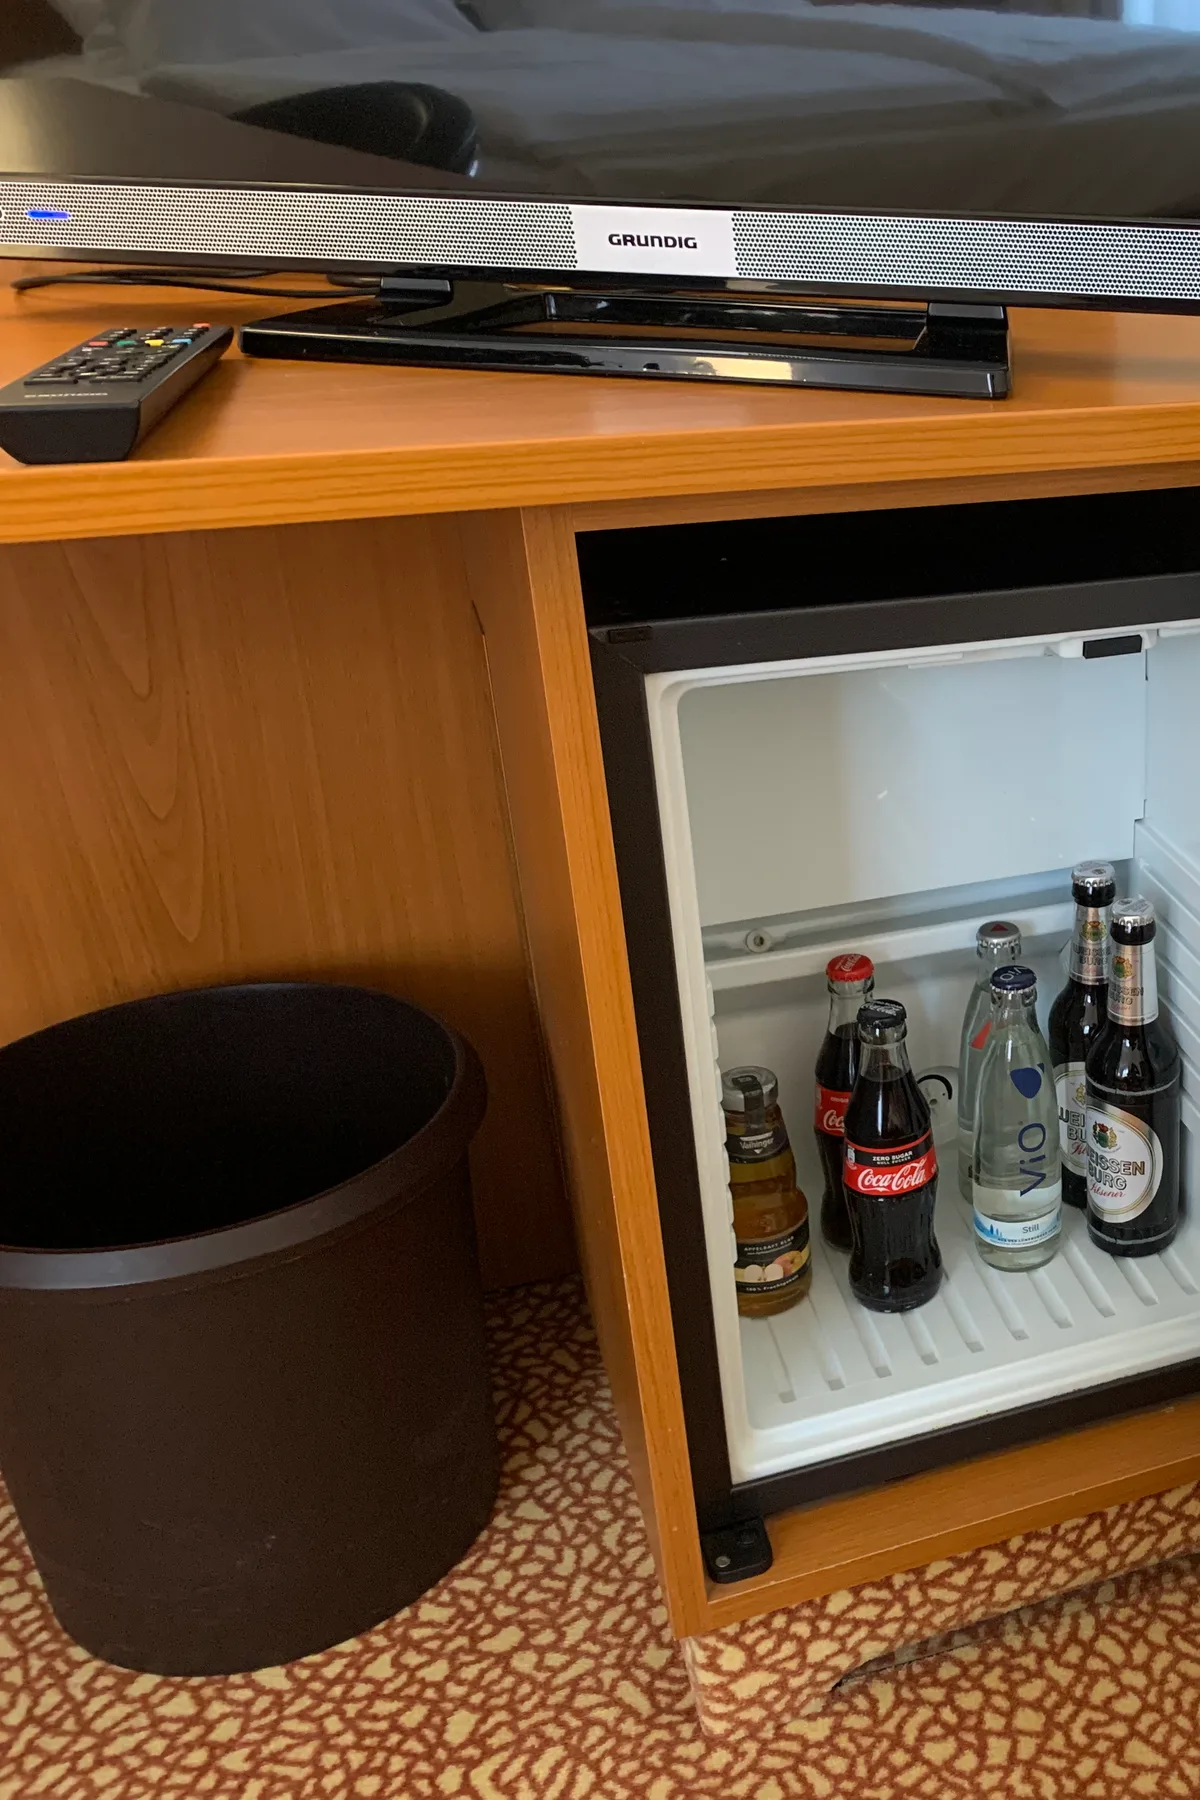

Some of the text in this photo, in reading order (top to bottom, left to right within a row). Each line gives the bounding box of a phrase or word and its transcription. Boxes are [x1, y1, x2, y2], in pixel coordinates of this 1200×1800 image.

[608, 233, 698, 249] GRUNDIG
[739, 1137, 774, 1150] Vaihinger
[891, 1150, 913, 1161] SUGAR
[858, 1158, 927, 1192] Coca-Cola
[1022, 1223, 1040, 1234] Still
